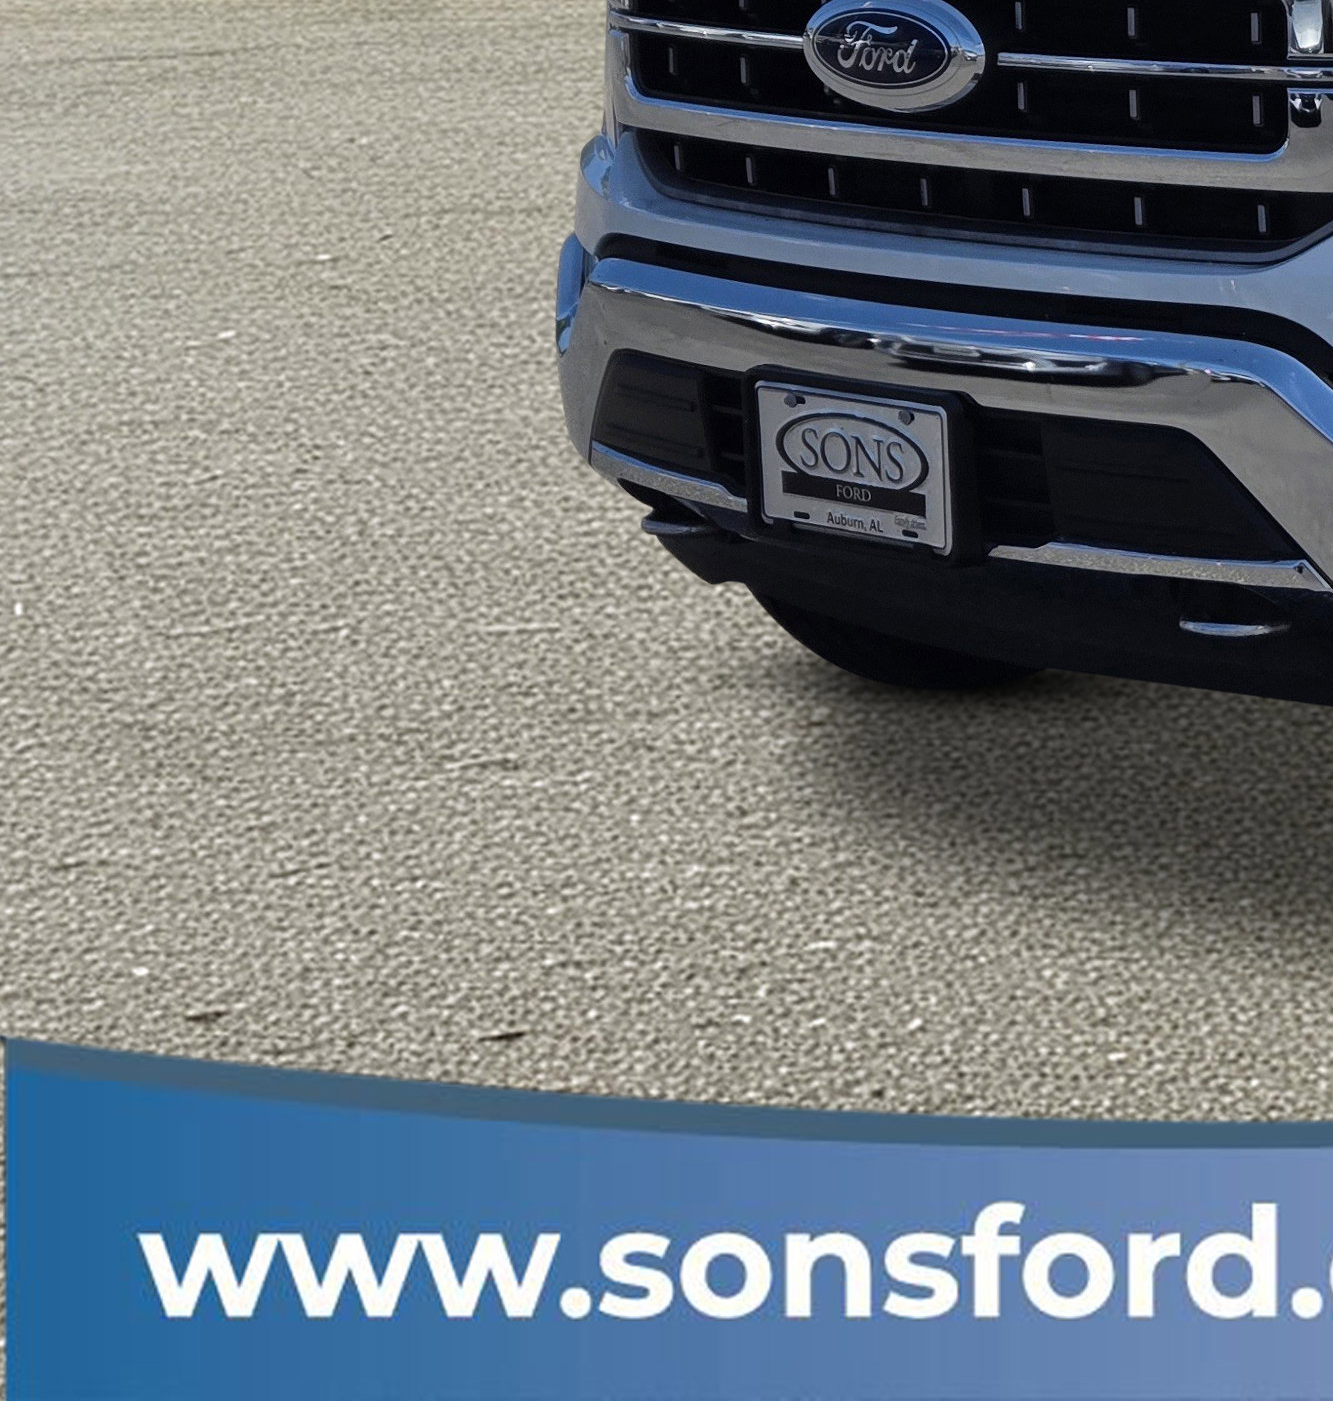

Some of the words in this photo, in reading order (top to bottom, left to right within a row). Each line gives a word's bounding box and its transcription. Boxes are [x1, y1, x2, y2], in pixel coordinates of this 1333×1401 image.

[837, 20, 919, 74] Ford
[800, 427, 904, 483] SONS
[836, 484, 872, 502] FORD
[869, 519, 884, 533] AL
